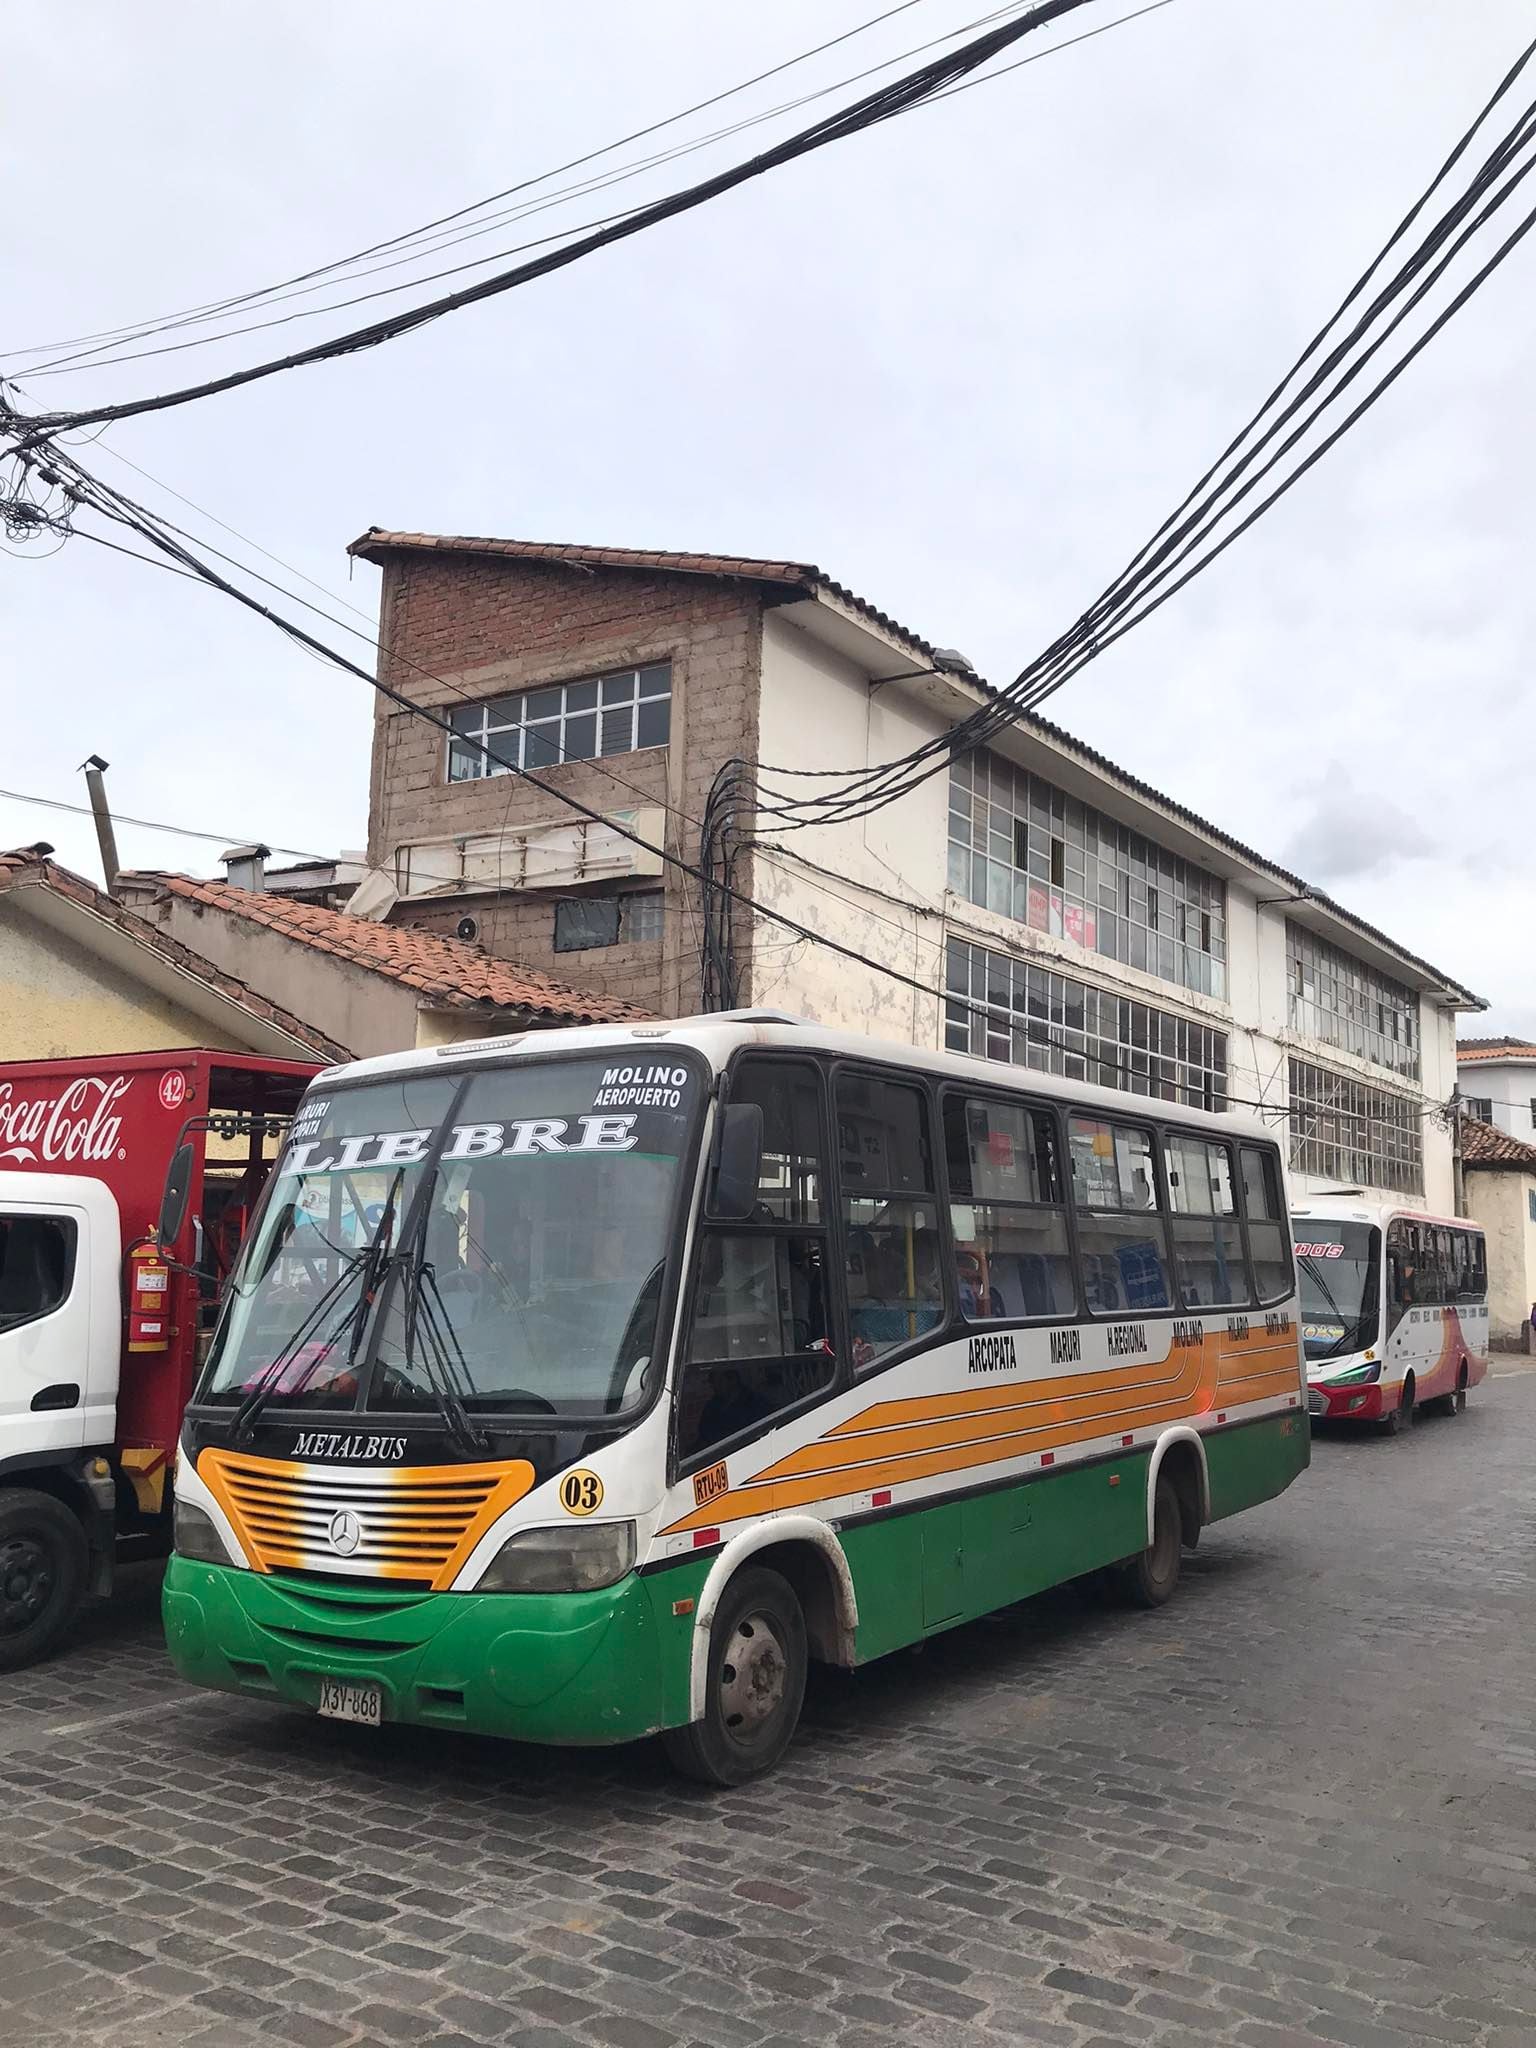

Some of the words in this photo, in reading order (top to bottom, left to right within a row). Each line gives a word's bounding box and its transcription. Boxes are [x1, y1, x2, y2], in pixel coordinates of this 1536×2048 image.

[163, 1076, 182, 1102] 42
[601, 1066, 688, 1086] MOLINO
[593, 1087, 681, 1108] AEROPUERTO
[968, 1336, 1017, 1373] ARCOPATA
[1050, 1330, 1082, 1364] MARURI
[1107, 1324, 1148, 1356] H.REGIONAL
[1173, 1319, 1204, 1348] MOLINO
[290, 1432, 408, 1460] METALBUS
[565, 1476, 598, 1509] 03
[696, 1466, 725, 1501] RTU-09
[323, 1683, 377, 1718] X3Y-868
